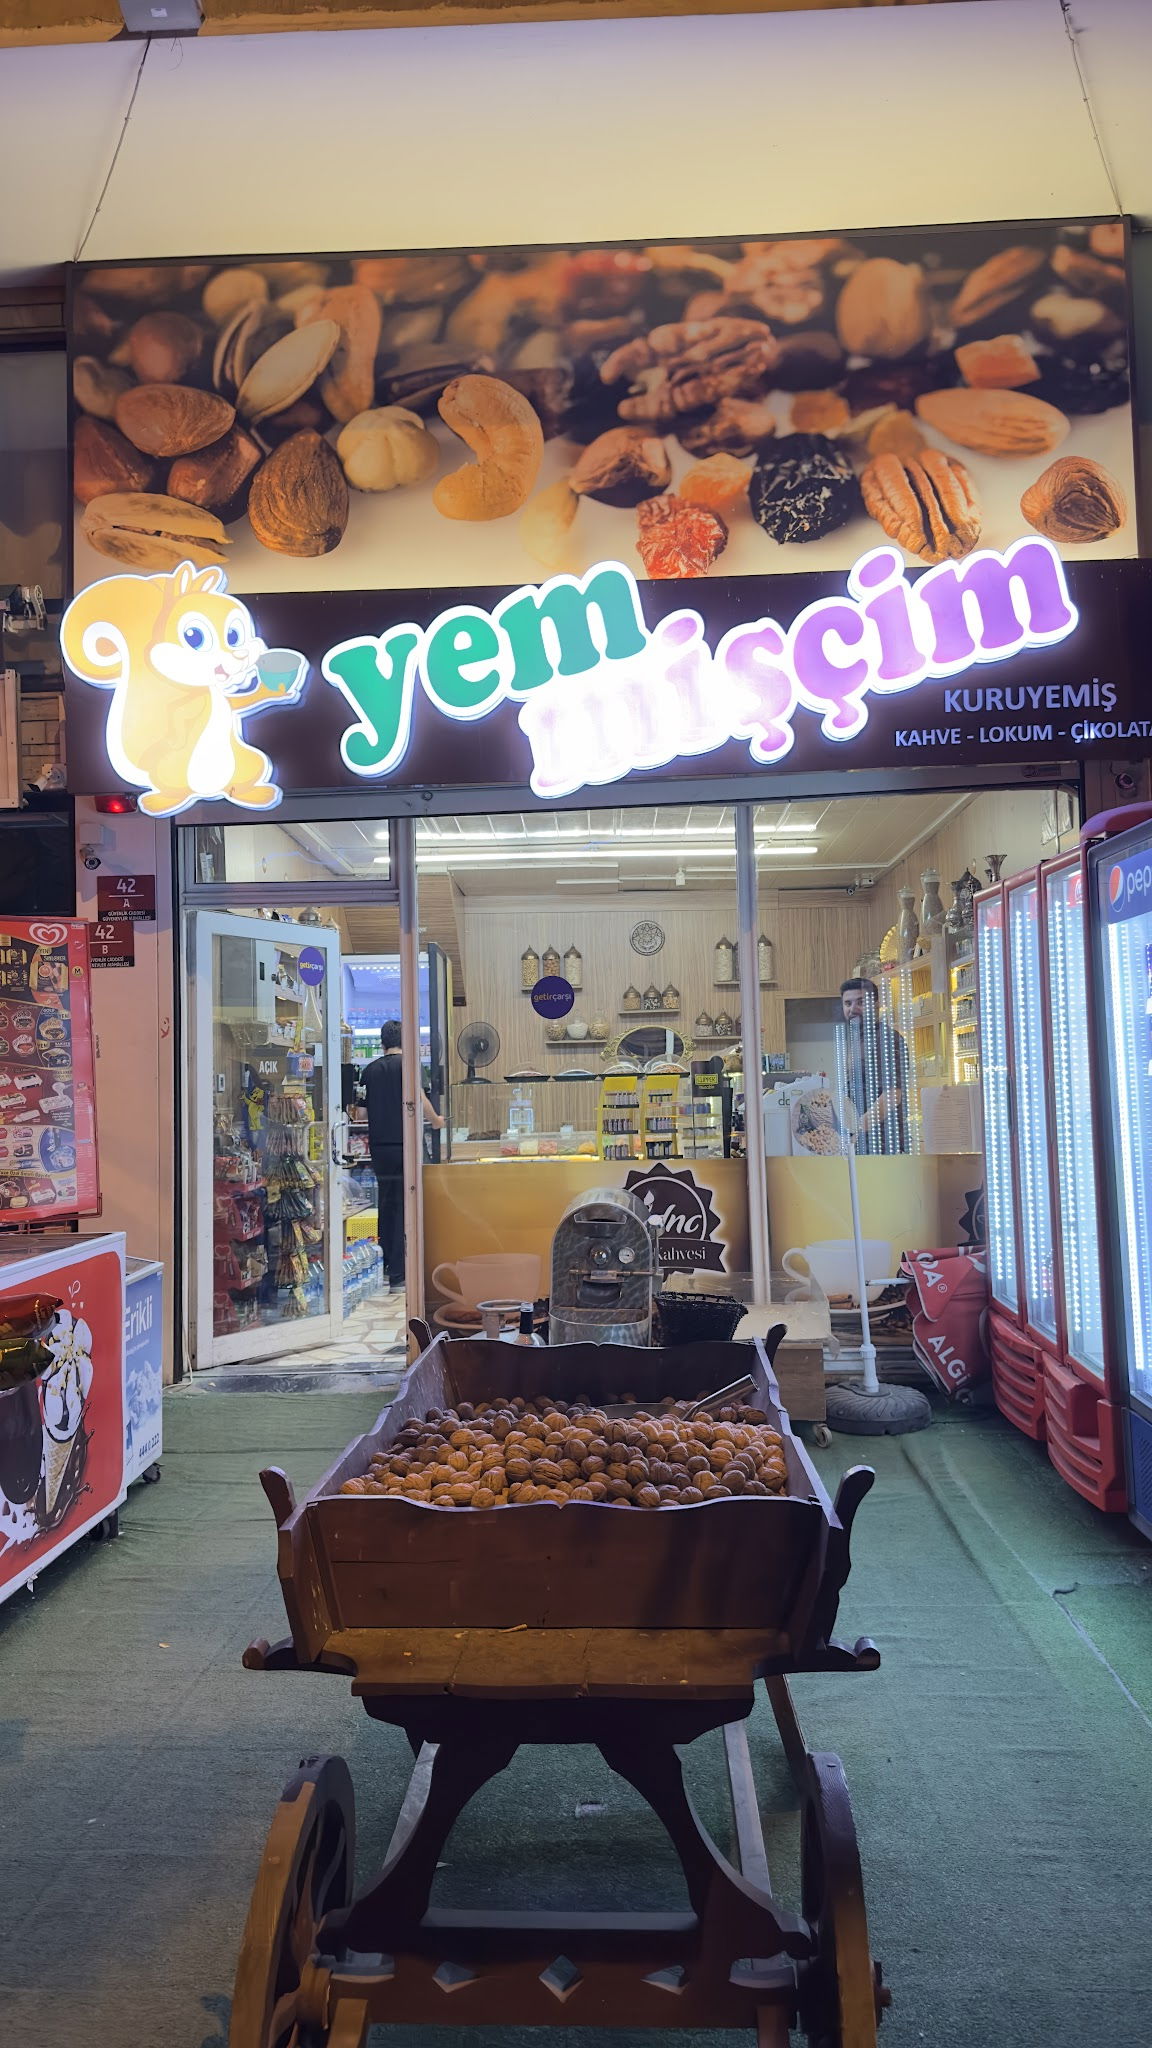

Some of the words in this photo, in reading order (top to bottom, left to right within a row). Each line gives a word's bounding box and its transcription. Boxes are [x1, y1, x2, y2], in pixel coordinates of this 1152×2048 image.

[326, 566, 649, 770] yem
[944, 678, 1118, 712] KURUYEMİŞ
[895, 728, 962, 747] KAHVE
[979, 725, 1053, 743] LOKUM
[1070, 720, 1152, 744] ÇİKOLAT
[116, 878, 136, 893] 42
[122, 898, 131, 908] A
[95, 924, 115, 940] 42
[102, 944, 109, 954] B
[533, 993, 572, 1003] getirçarşı
[259, 1060, 278, 1074] AÇIK
[124, 1294, 153, 1343] Erikli
